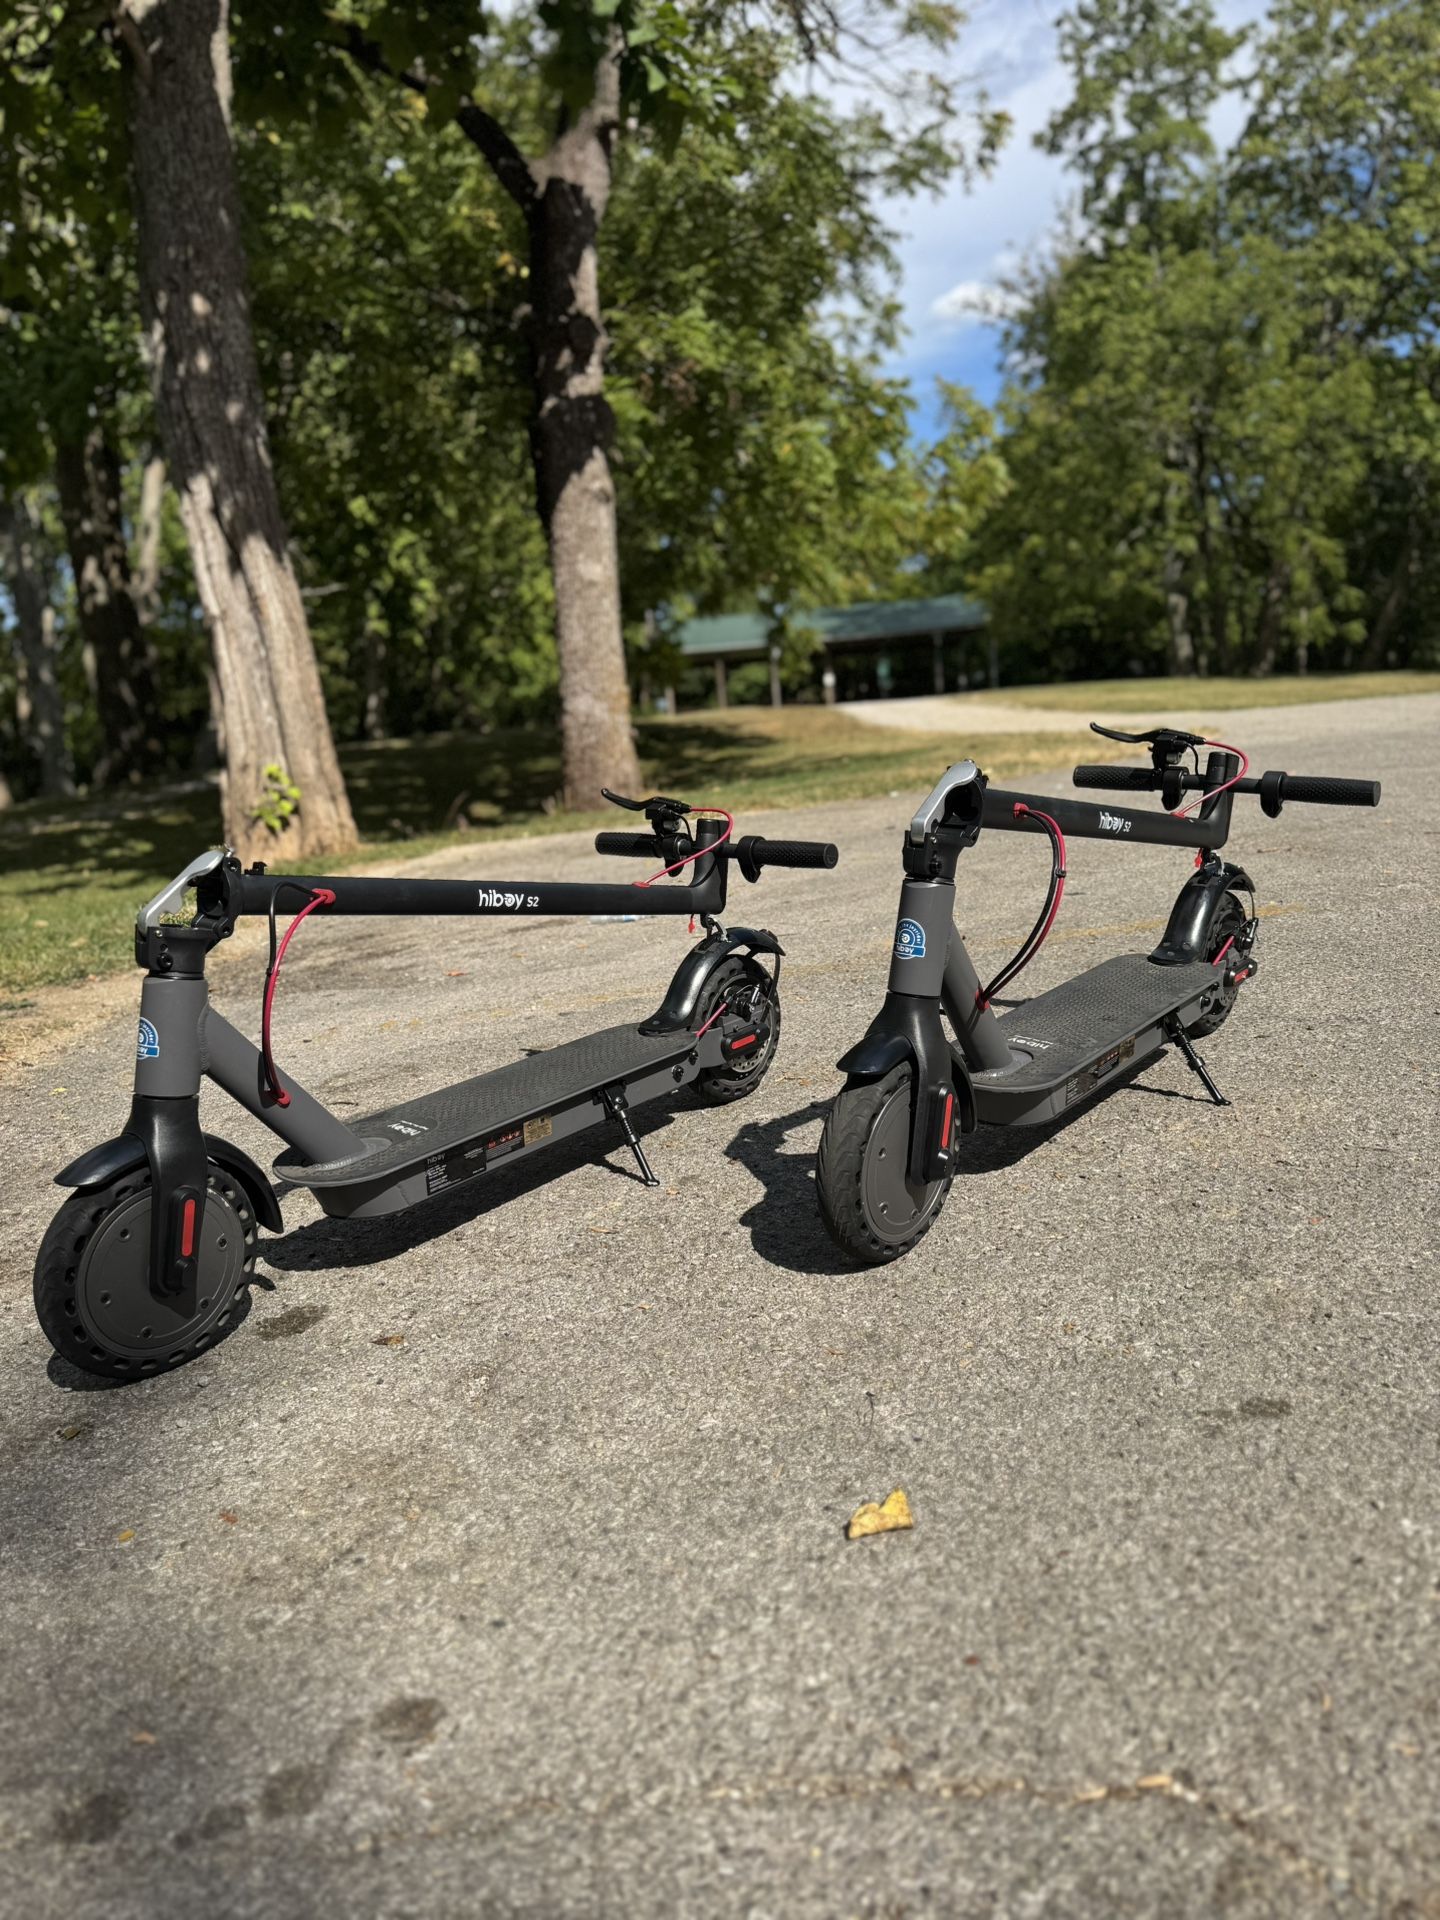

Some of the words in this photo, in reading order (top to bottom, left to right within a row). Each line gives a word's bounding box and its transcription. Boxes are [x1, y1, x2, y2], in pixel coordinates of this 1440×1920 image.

[1098, 811, 1125, 834] hiboy
[478, 888, 525, 911] hiboy
[526, 896, 540, 907] S2
